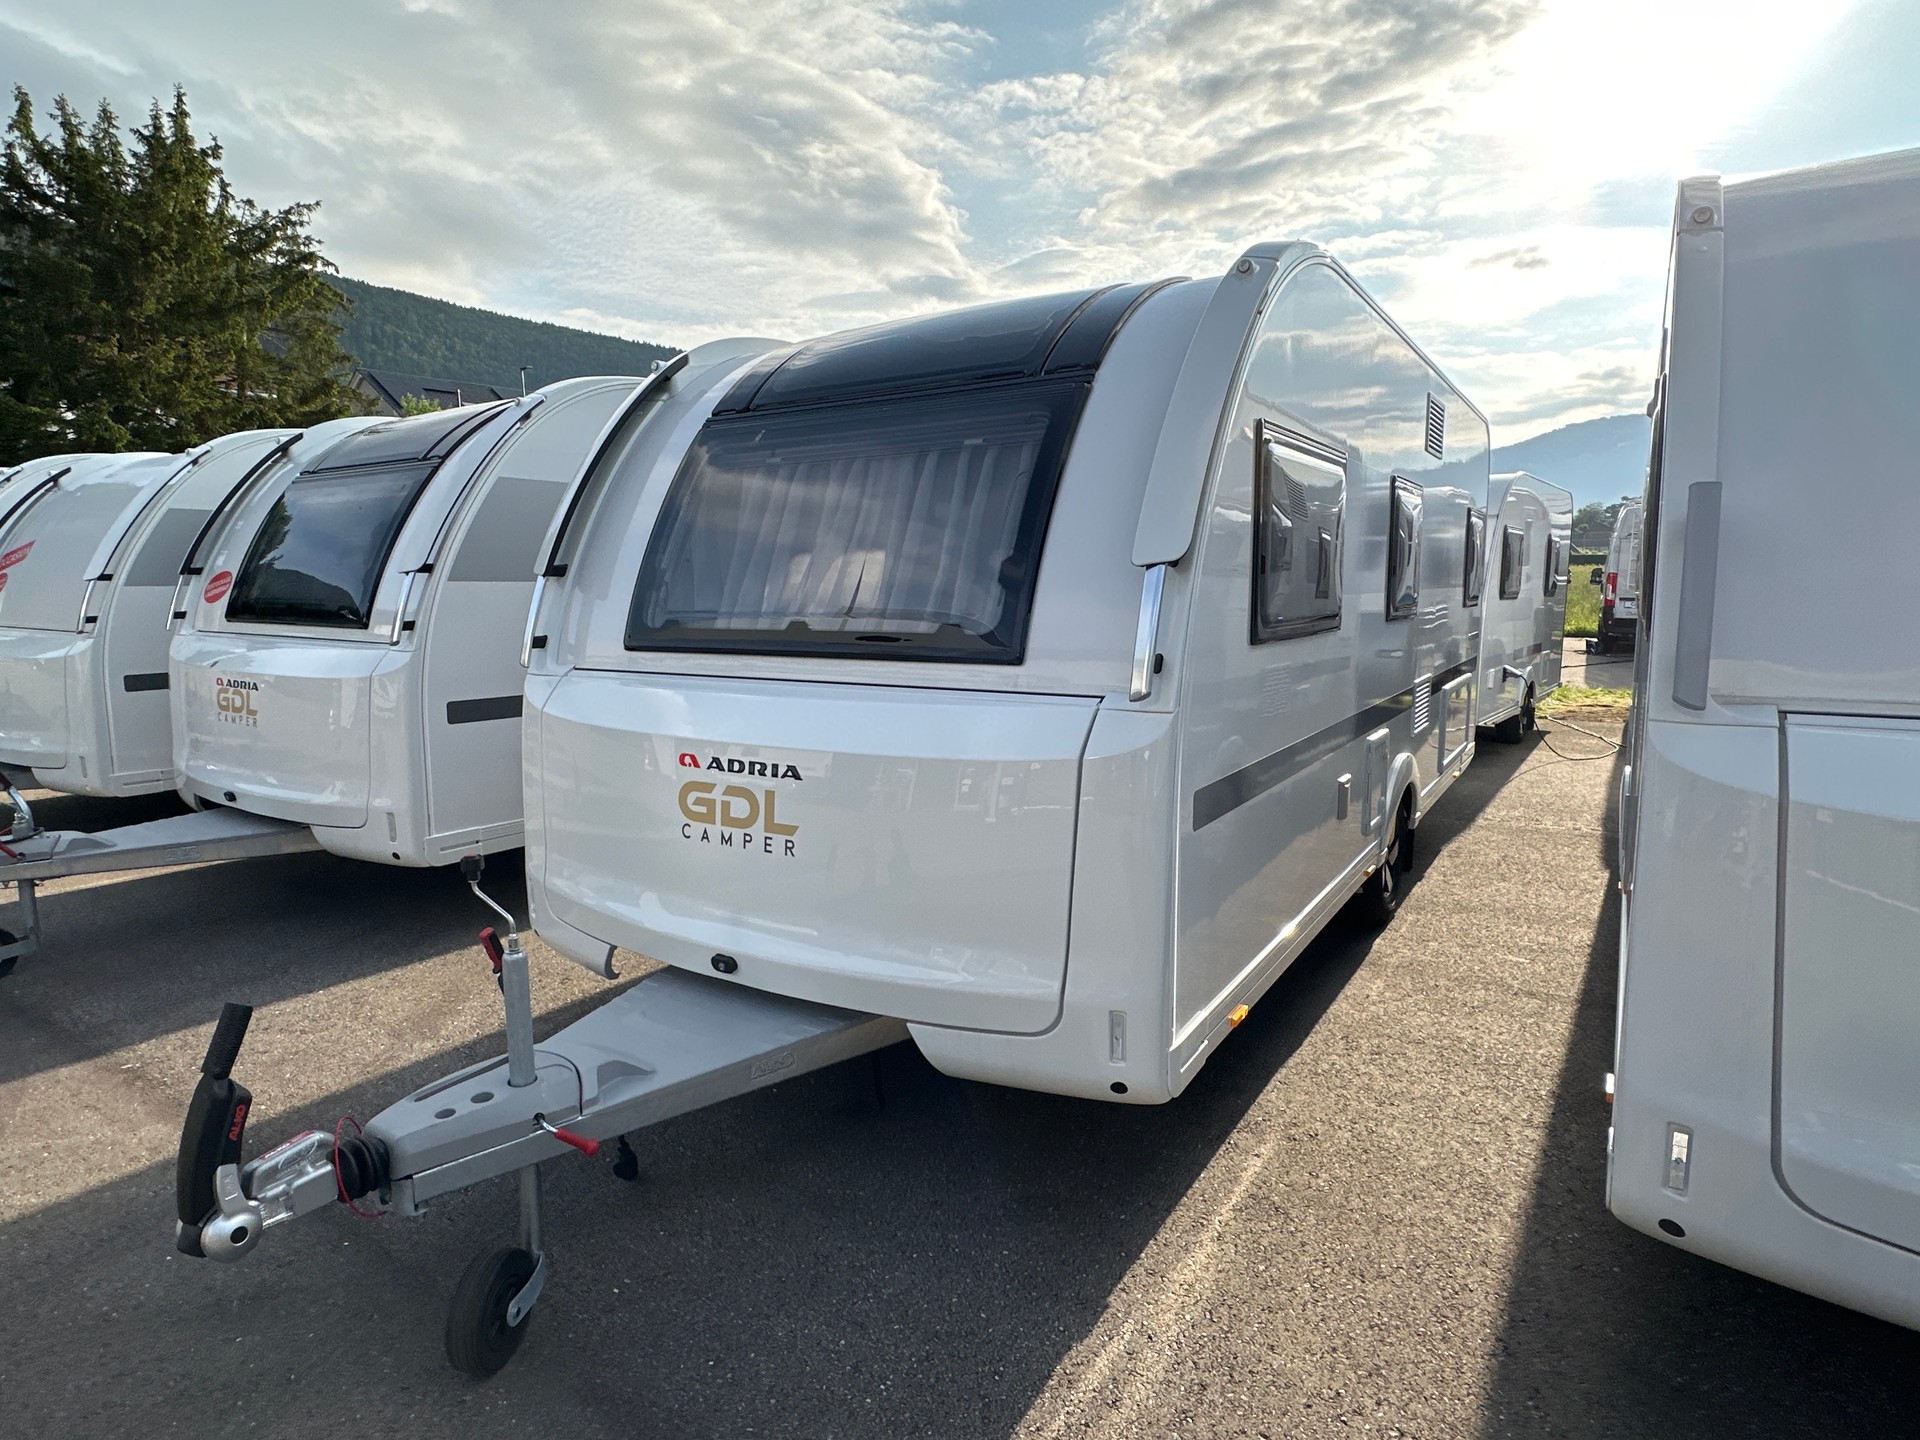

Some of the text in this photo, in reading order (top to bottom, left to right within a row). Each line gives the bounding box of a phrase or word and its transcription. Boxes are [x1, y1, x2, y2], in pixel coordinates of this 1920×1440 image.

[226, 679, 259, 691] ADRIA
[217, 687, 258, 716] GDL
[218, 712, 257, 728] CAMPER
[706, 756, 803, 781] ADRIA
[678, 780, 799, 837] GDL
[681, 823, 795, 857] CAMPER
